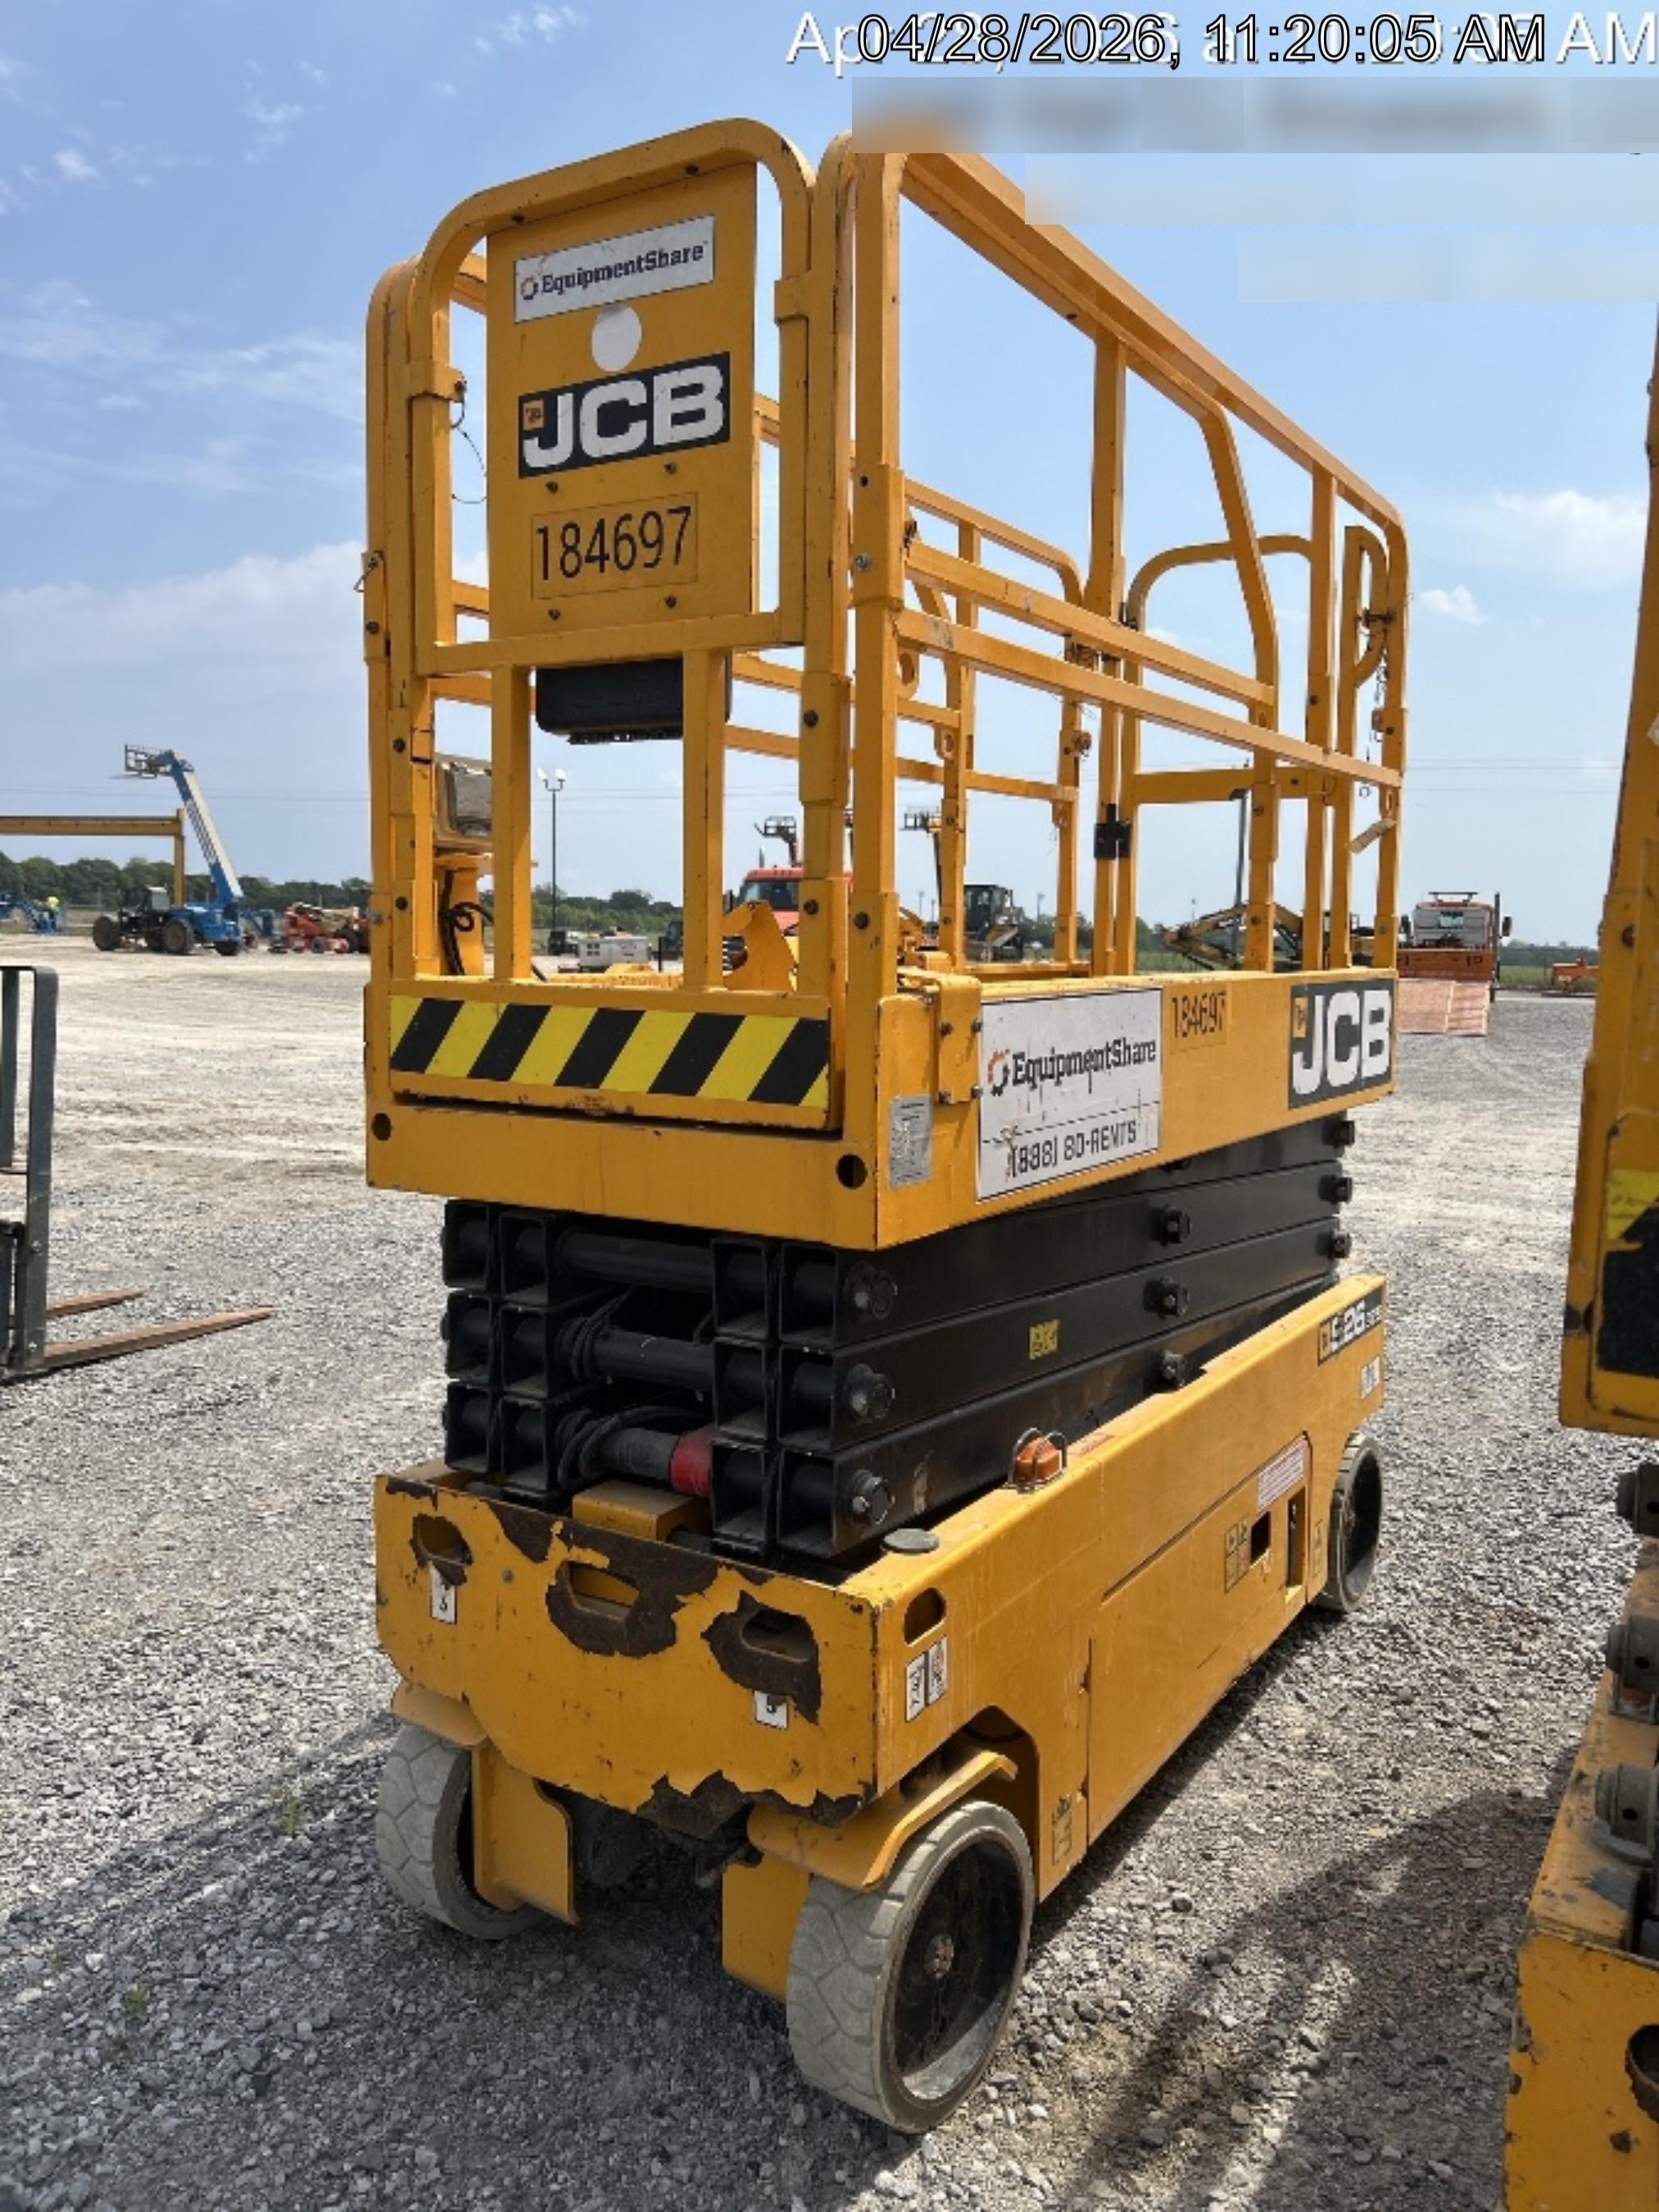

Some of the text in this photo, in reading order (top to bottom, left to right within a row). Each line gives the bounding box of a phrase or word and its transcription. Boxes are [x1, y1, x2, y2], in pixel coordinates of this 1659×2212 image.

[541, 242, 705, 295] EquipmentShare
[522, 365, 724, 469] JCB
[536, 505, 692, 582] 184697
[1172, 991, 1226, 1038] 184697
[1292, 989, 1392, 1095] JCB
[1012, 1036, 1157, 1091] EquipmentShare
